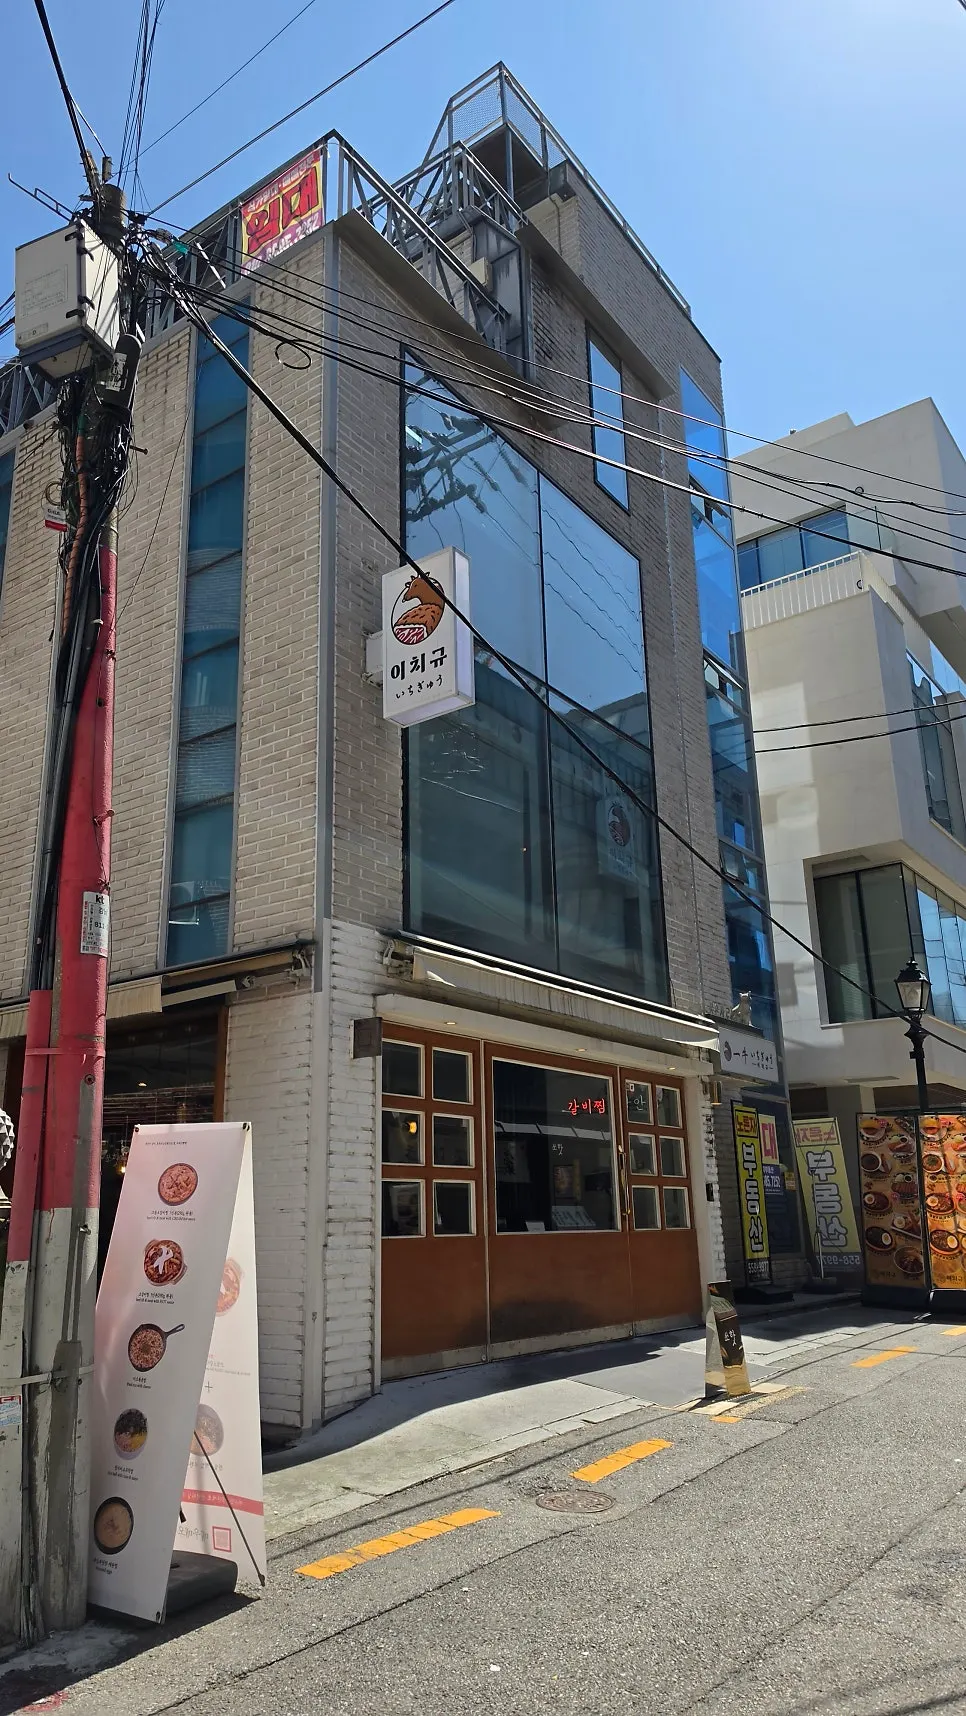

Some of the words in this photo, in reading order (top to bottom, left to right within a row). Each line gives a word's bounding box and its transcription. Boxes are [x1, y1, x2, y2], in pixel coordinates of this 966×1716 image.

[246, 165, 319, 254] 임대
[390, 646, 448, 681] 이치규
[395, 674, 443, 699] いちぎゅう
[95, 894, 105, 905] kt
[568, 1097, 606, 1116] 갈비찜
[741, 1141, 764, 1253] 부동산
